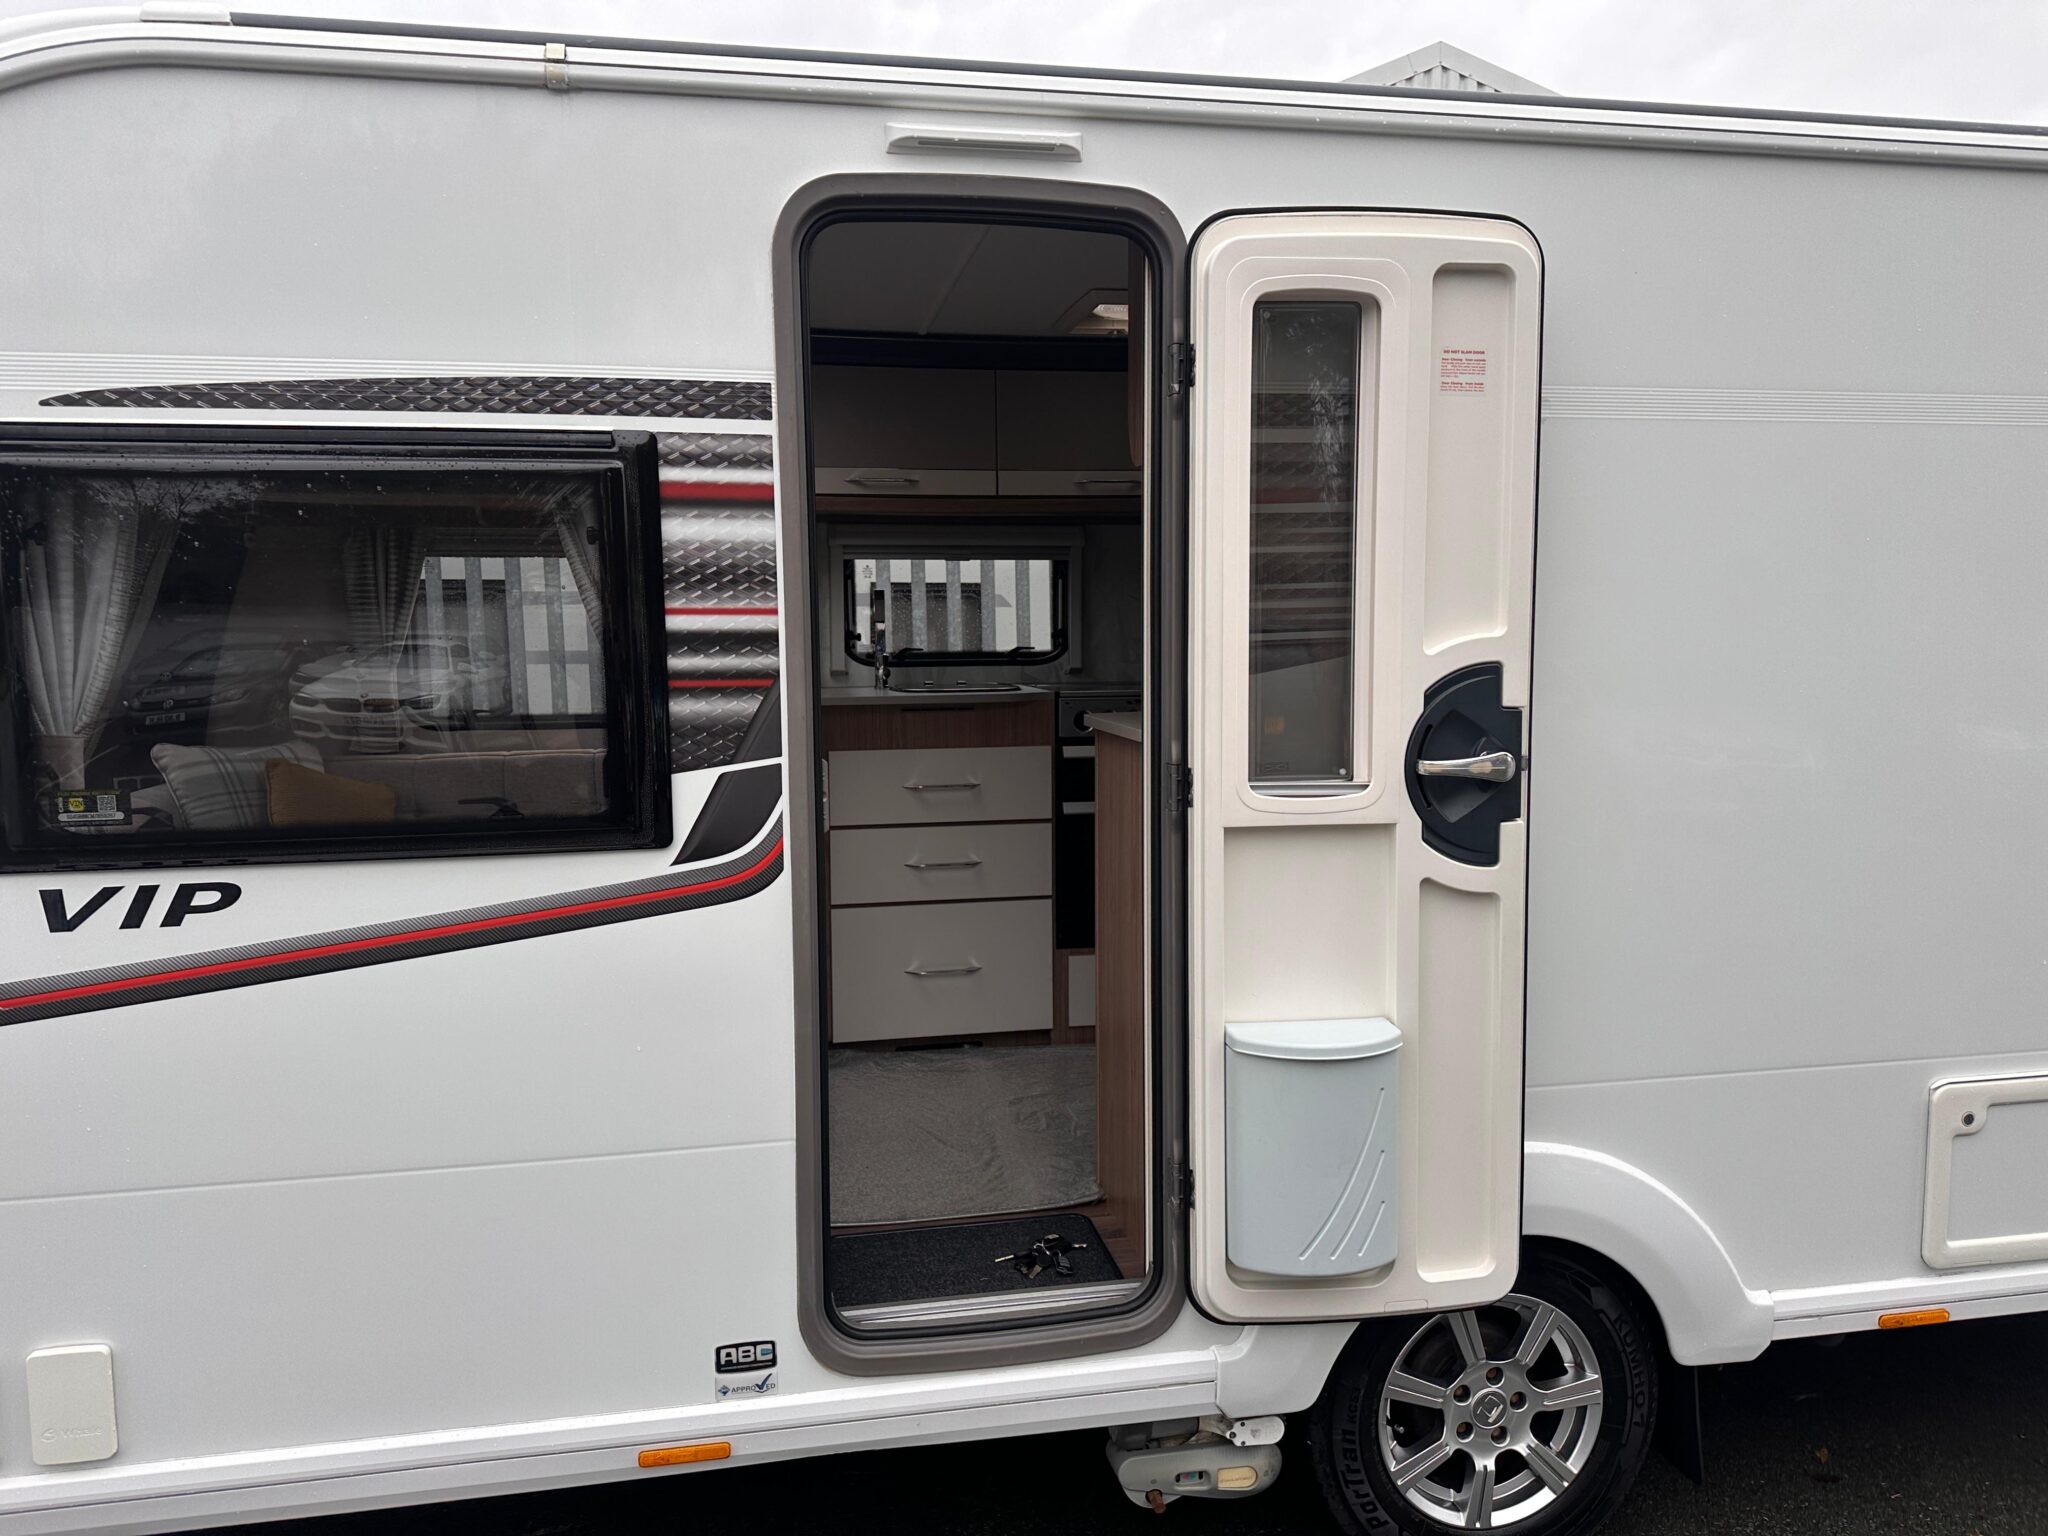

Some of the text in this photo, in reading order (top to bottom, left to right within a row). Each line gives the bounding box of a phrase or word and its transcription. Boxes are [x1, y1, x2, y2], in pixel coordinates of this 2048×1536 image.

[69, 799, 83, 807] VIN
[39, 882, 242, 933] VIP
[719, 1343, 773, 1365] ABC
[1613, 1313, 1646, 1408] KUMHO
[731, 1380, 776, 1393] APPROVED
[1338, 1429, 1390, 1530] PorTran
